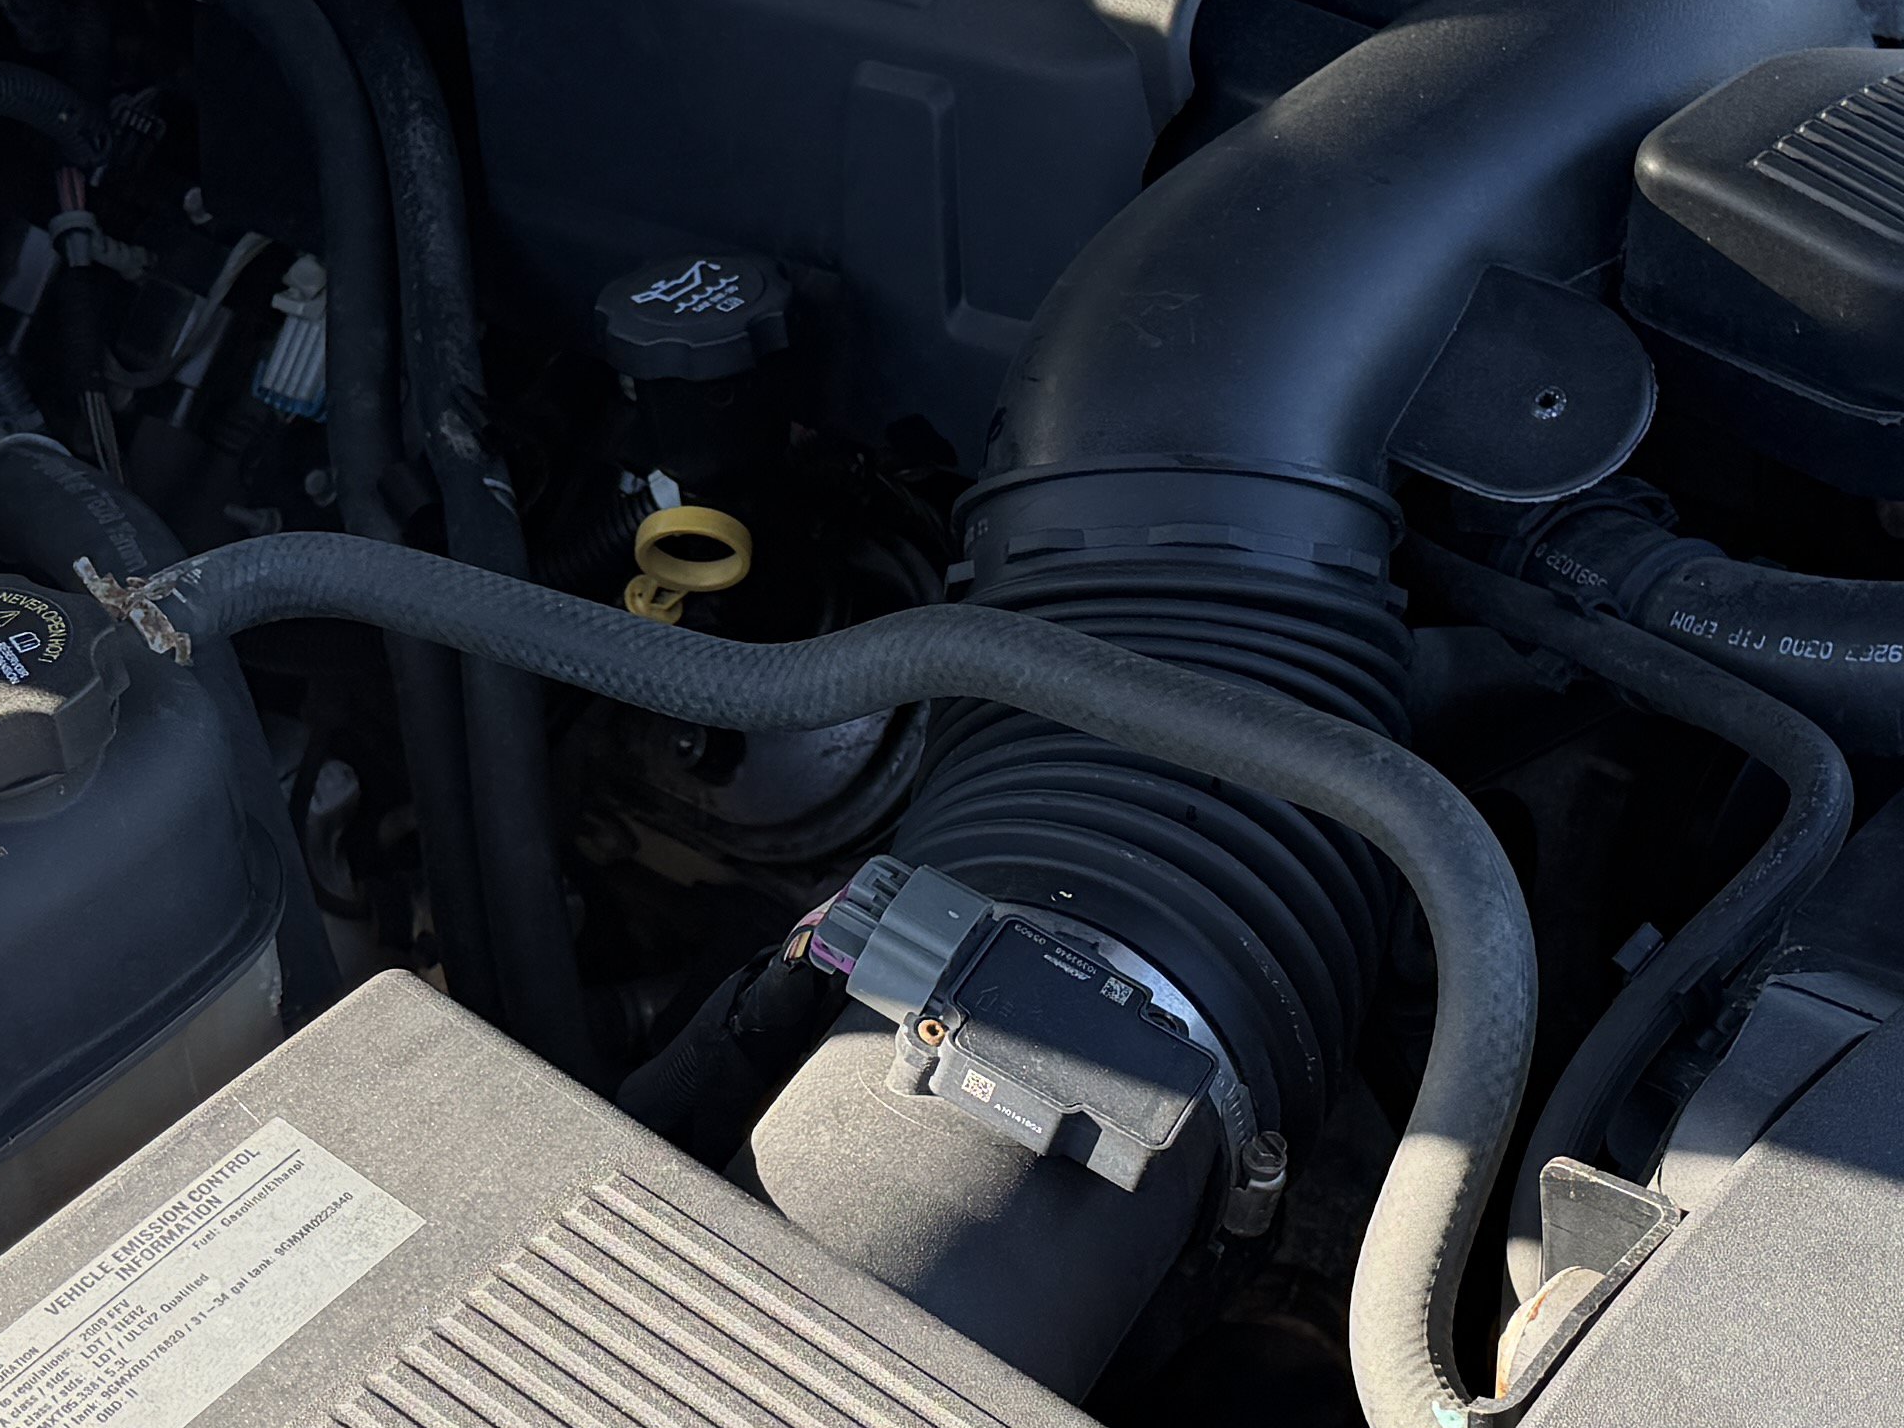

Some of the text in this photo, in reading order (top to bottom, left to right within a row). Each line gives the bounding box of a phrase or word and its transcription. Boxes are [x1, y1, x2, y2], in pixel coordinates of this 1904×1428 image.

[40, 609, 68, 638] OPEN
[1669, 609, 1719, 641] EPDM
[38, 635, 66, 663] HOT!
[1778, 635, 1835, 661] 0300
[218, 1157, 306, 1228] Gasoline/Ethanol
[42, 1143, 260, 1318] VEHICLE EMISSION CONTROL
[112, 1192, 225, 1282] INFORMATION
[227, 1276, 251, 1295] gal
[77, 1316, 110, 1343] 2009
[6, 1392, 40, 1420] class
[79, 1337, 109, 1361] LDT
[109, 1304, 149, 1336] TIER2
[19, 1400, 54, 1428] class
[91, 1346, 120, 1369] LDT
[158, 1272, 211, 1314] Qualified
[103, 1354, 133, 1379] 5.3L
